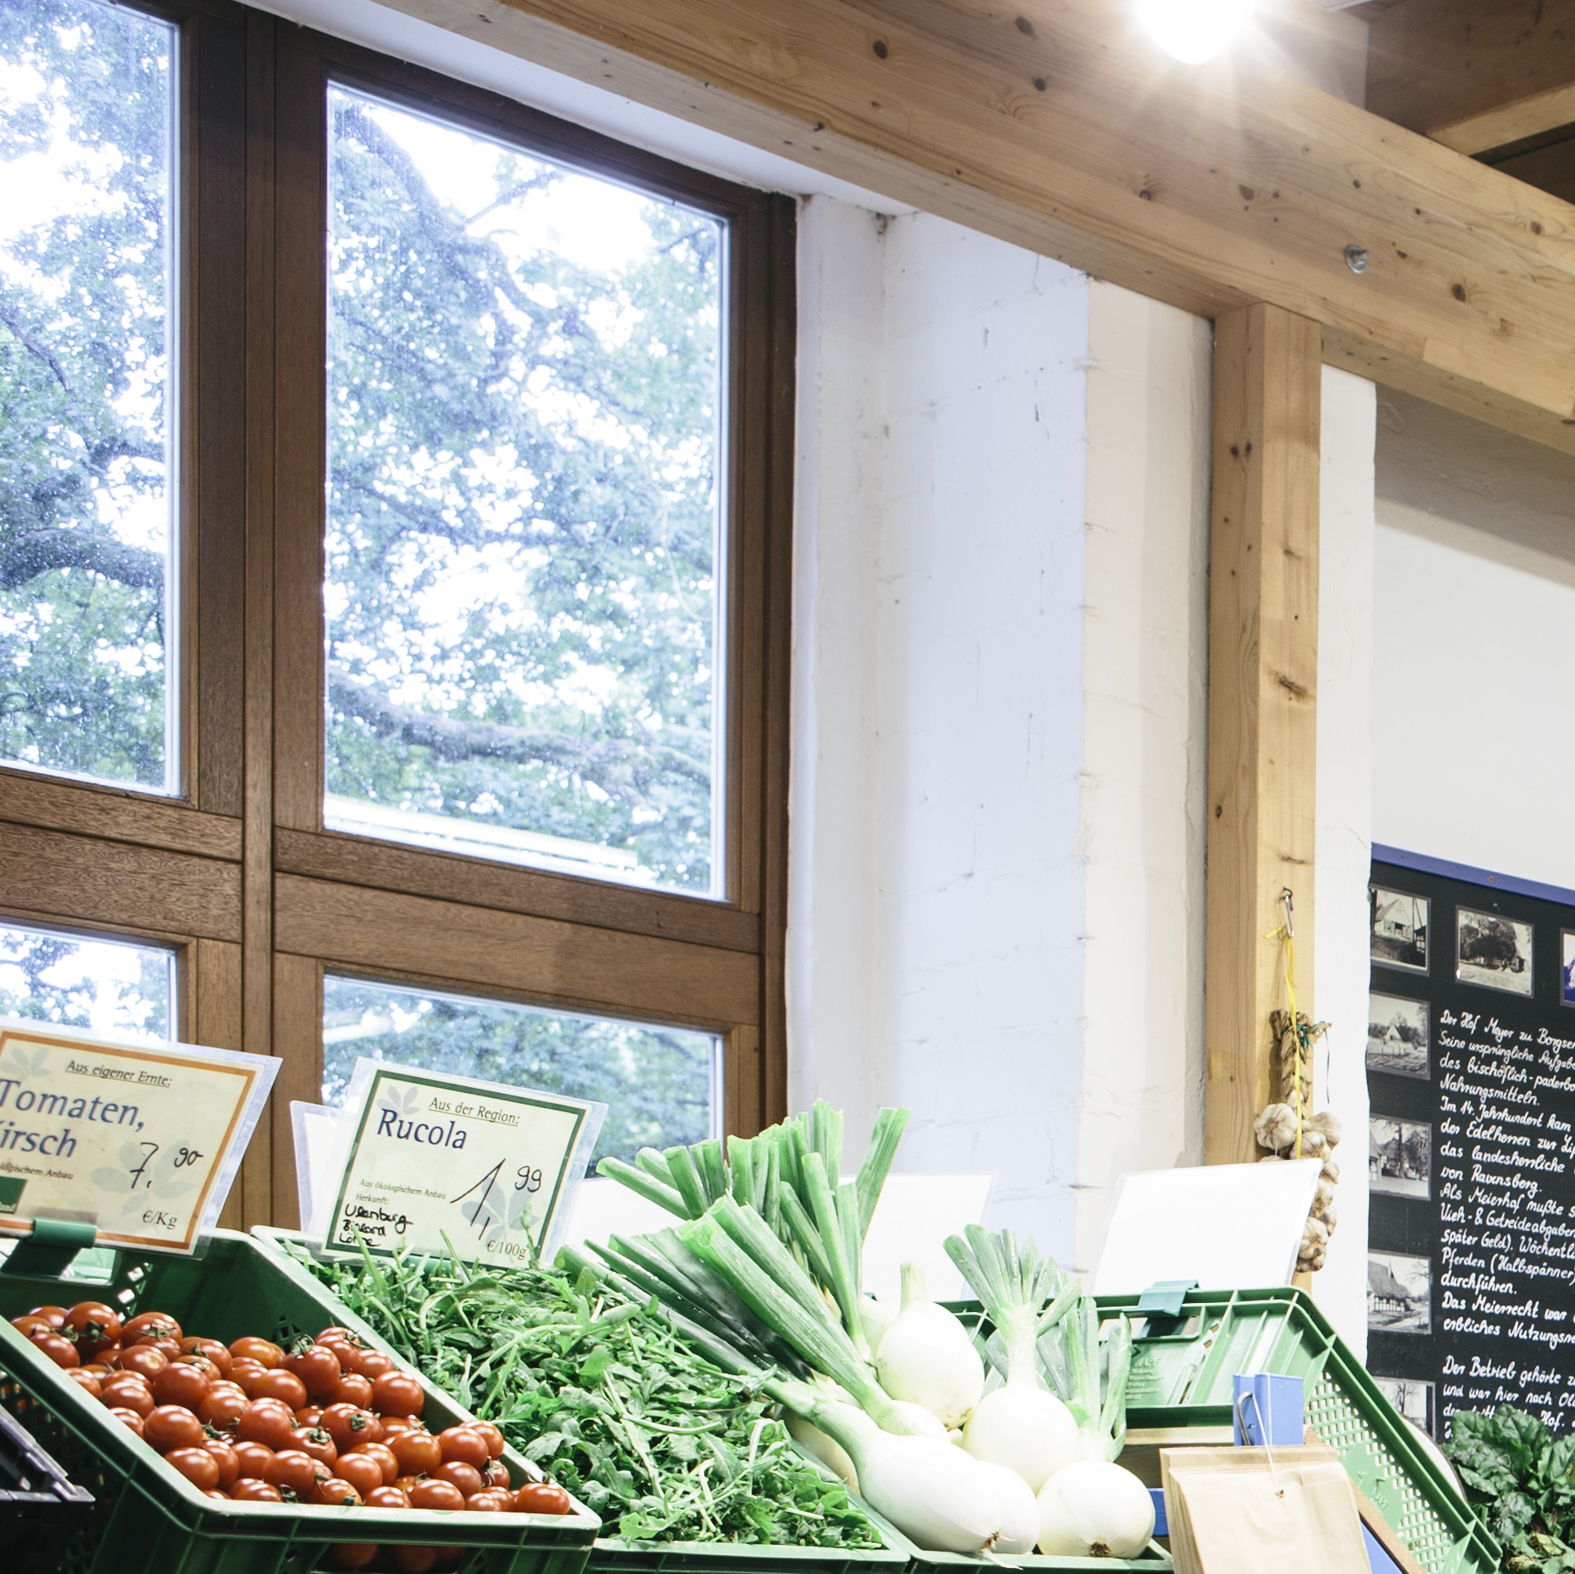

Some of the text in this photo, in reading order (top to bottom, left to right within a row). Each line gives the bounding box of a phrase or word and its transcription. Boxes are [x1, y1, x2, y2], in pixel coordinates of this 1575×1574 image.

[1438, 1029, 1467, 1049] Seine
[1439, 1009, 1459, 1026] Der
[1460, 1011, 1482, 1035] Hof
[1483, 1016, 1516, 1044] Meyer
[1518, 1031, 1534, 1042] zu
[66, 1058, 173, 1088] Aus eigener Ernte:
[1439, 1051, 1462, 1070] des
[0, 1077, 146, 1133] Tomaten,
[429, 1097, 521, 1127] Aus der Region:
[1439, 1095, 1458, 1113] Im
[1475, 1098, 1545, 1128] Jahrhundert
[1546, 1113, 1573, 1133] kam
[377, 1108, 468, 1150] Rucola
[1440, 1116, 1462, 1135] der
[1537, 1137, 1558, 1151] zur
[46, 1168, 74, 1180] Anbau
[1439, 1182, 1463, 1201] Als
[1468, 1186, 1526, 1215] Meierhof
[1526, 1198, 1565, 1218] mußte
[143, 1210, 179, 1230] €/Kg
